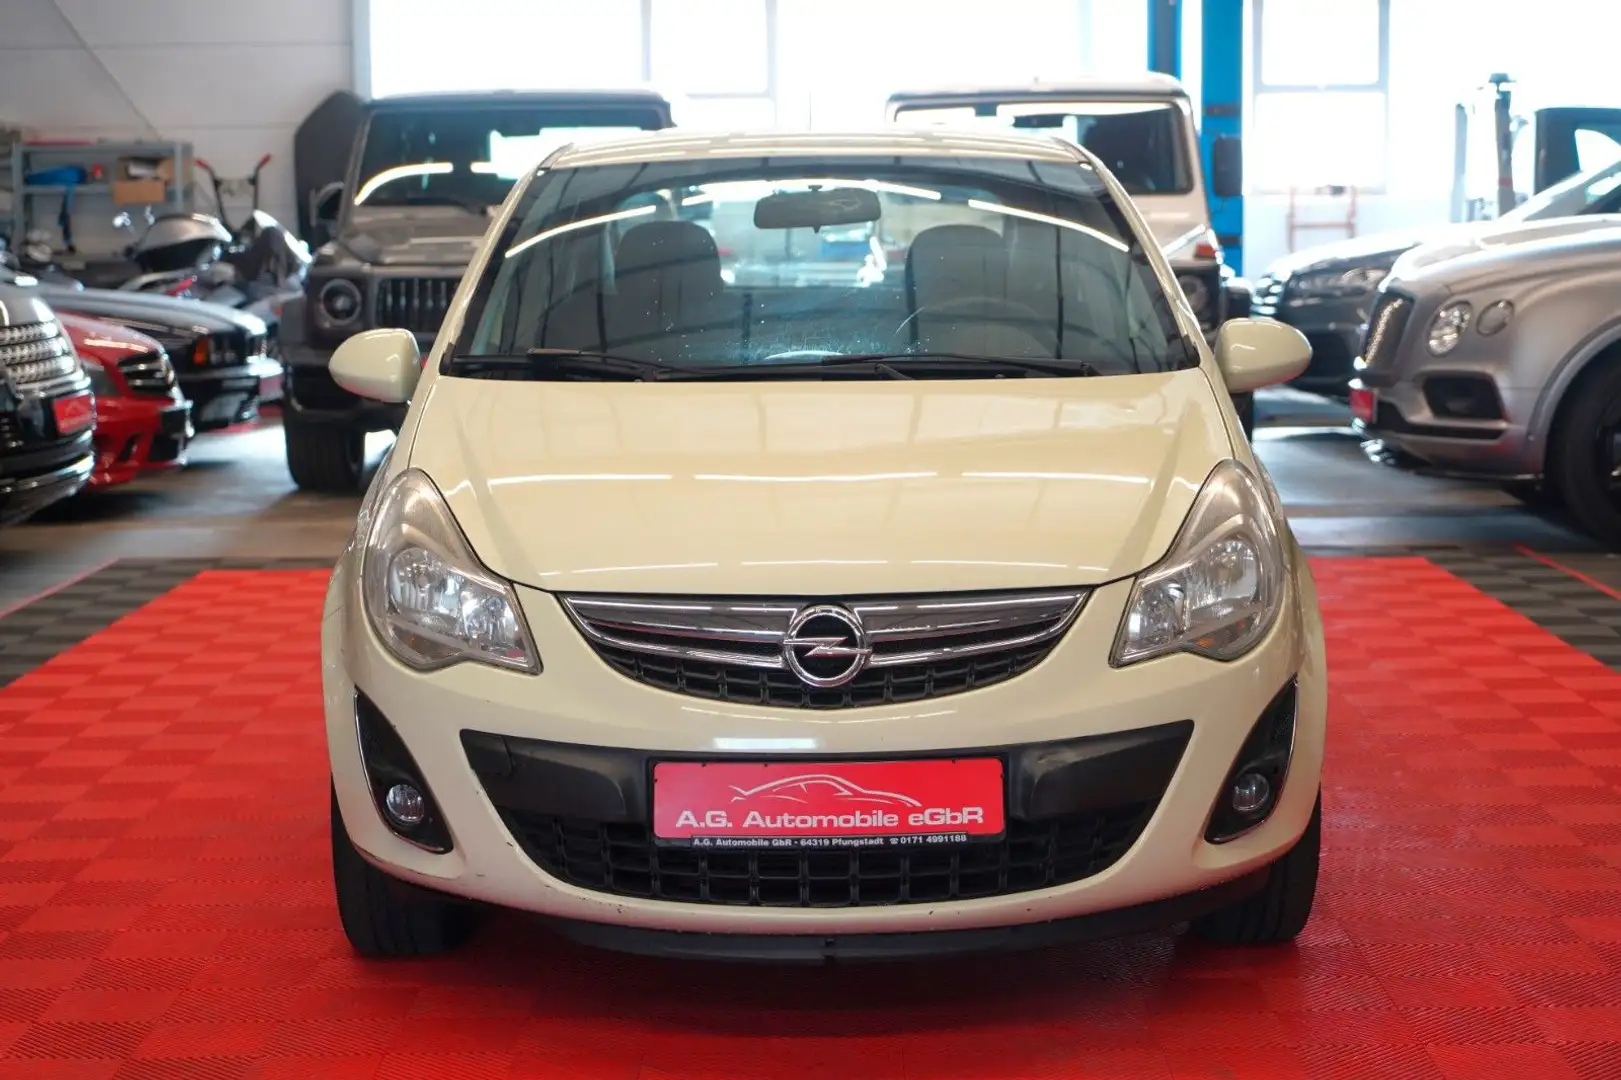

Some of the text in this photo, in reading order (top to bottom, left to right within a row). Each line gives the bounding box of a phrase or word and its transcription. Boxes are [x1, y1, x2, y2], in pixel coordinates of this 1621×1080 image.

[676, 807, 984, 828] A.G. Automobile eGbR
[693, 838, 713, 846] A.G.
[715, 838, 769, 847] Automobile
[771, 838, 792, 847] GbR
[799, 838, 830, 846] 64319
[831, 837, 884, 847] Pfungstadt
[900, 836, 923, 844] 0171
